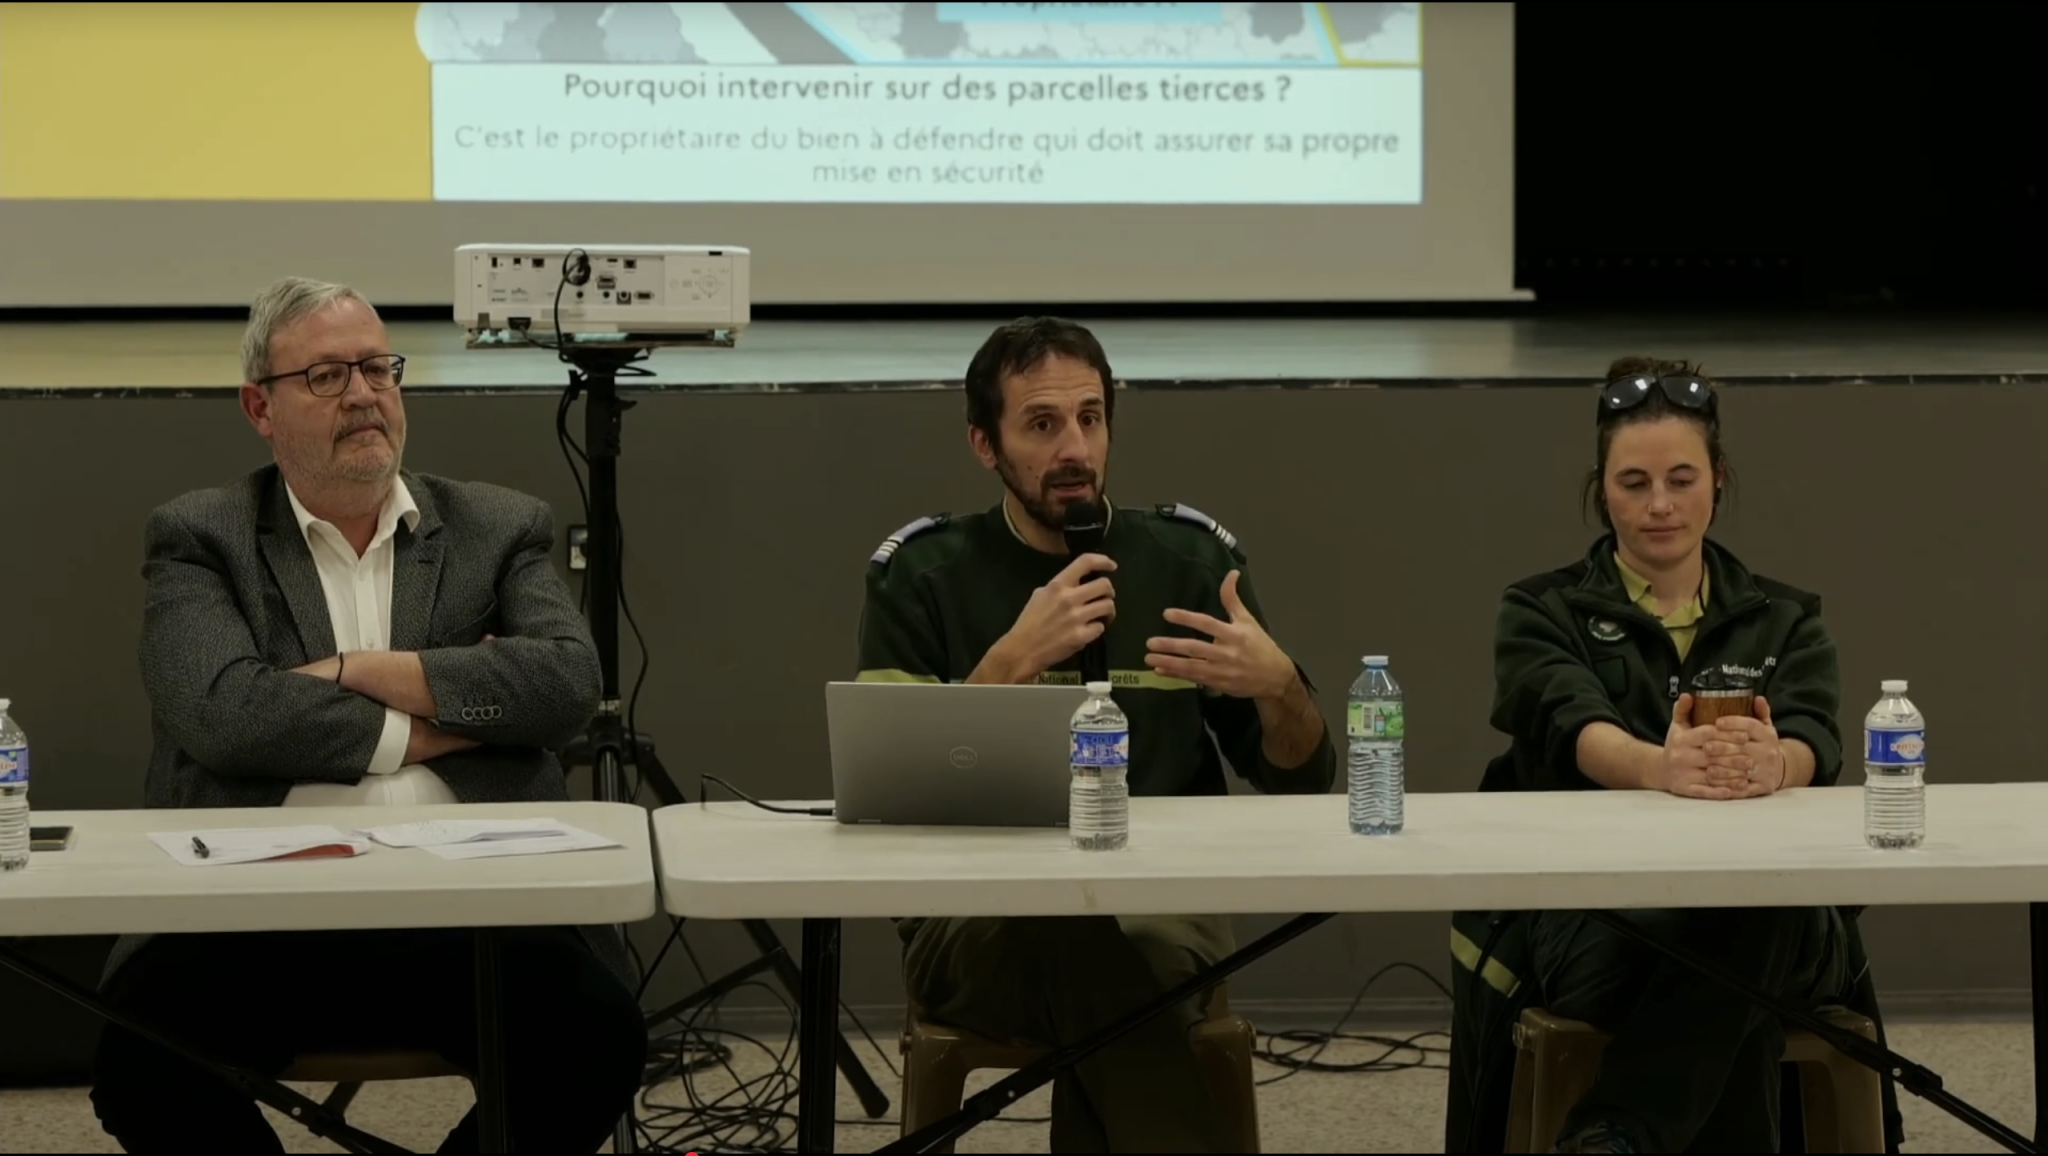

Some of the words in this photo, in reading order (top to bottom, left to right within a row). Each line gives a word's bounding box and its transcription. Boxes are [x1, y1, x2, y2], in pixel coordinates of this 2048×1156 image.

[563, 71, 706, 106] Pourquoi
[717, 71, 873, 101] intervenir
[884, 79, 931, 101] sur
[942, 73, 997, 101] des
[1008, 74, 1149, 107] parcelles
[1159, 74, 1266, 103] tierces
[1276, 75, 1292, 103] ?
[454, 125, 525, 149] C'est
[536, 125, 560, 149] le
[570, 125, 741, 154] propriétaire
[751, 125, 788, 150] du
[797, 126, 860, 150] bien
[870, 126, 884, 151] à
[893, 126, 1024, 151] défendre
[1033, 128, 1078, 157] qui
[1087, 126, 1144, 152] doit
[1154, 133, 1255, 152] assurer
[1264, 134, 1293, 153] sa
[1301, 132, 1400, 158] propre
[812, 160, 877, 183] mise
[887, 165, 922, 183] en
[931, 160, 1045, 185] sécurité
[1111, 671, 1140, 686] orêts
